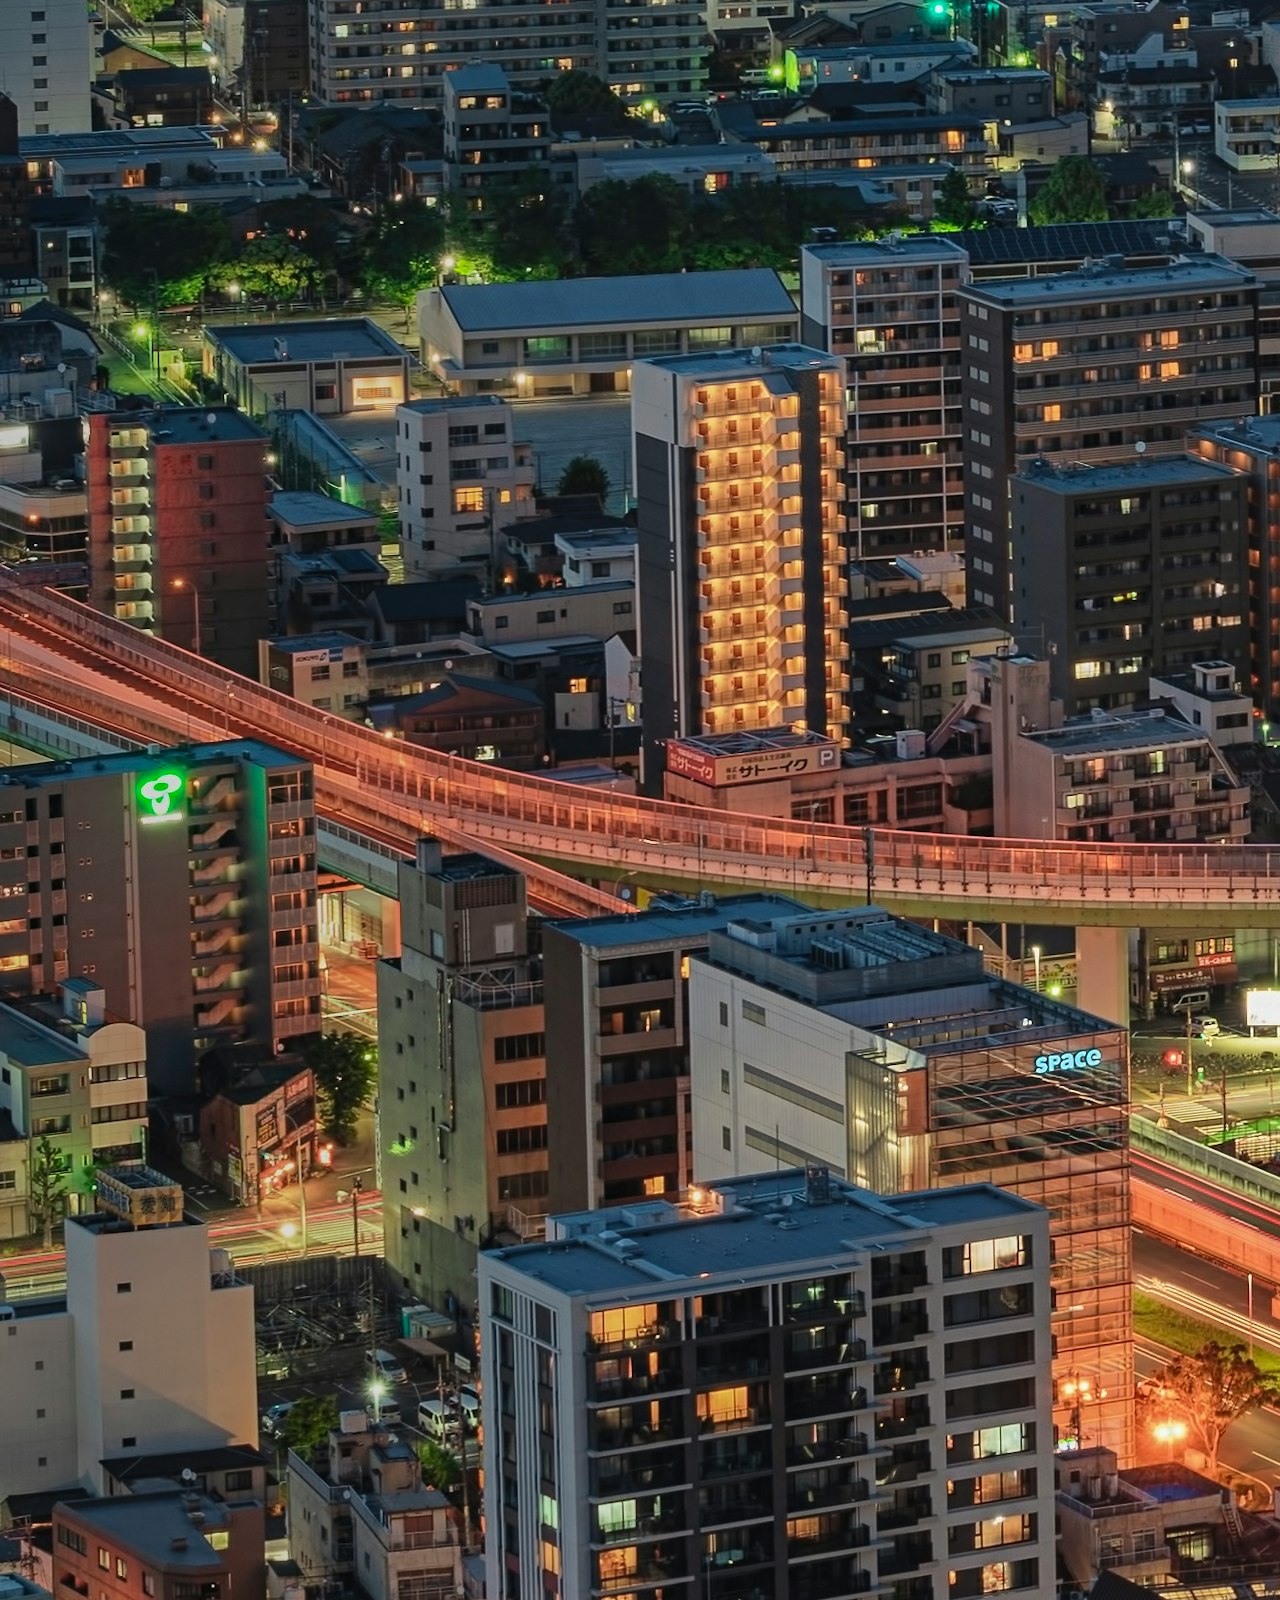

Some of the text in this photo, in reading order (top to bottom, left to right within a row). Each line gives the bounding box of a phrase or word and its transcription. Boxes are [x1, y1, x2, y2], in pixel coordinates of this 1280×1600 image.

[678, 755, 714, 780] サトーイク
[738, 758, 808, 779] サトーイク
[821, 751, 834, 766] P
